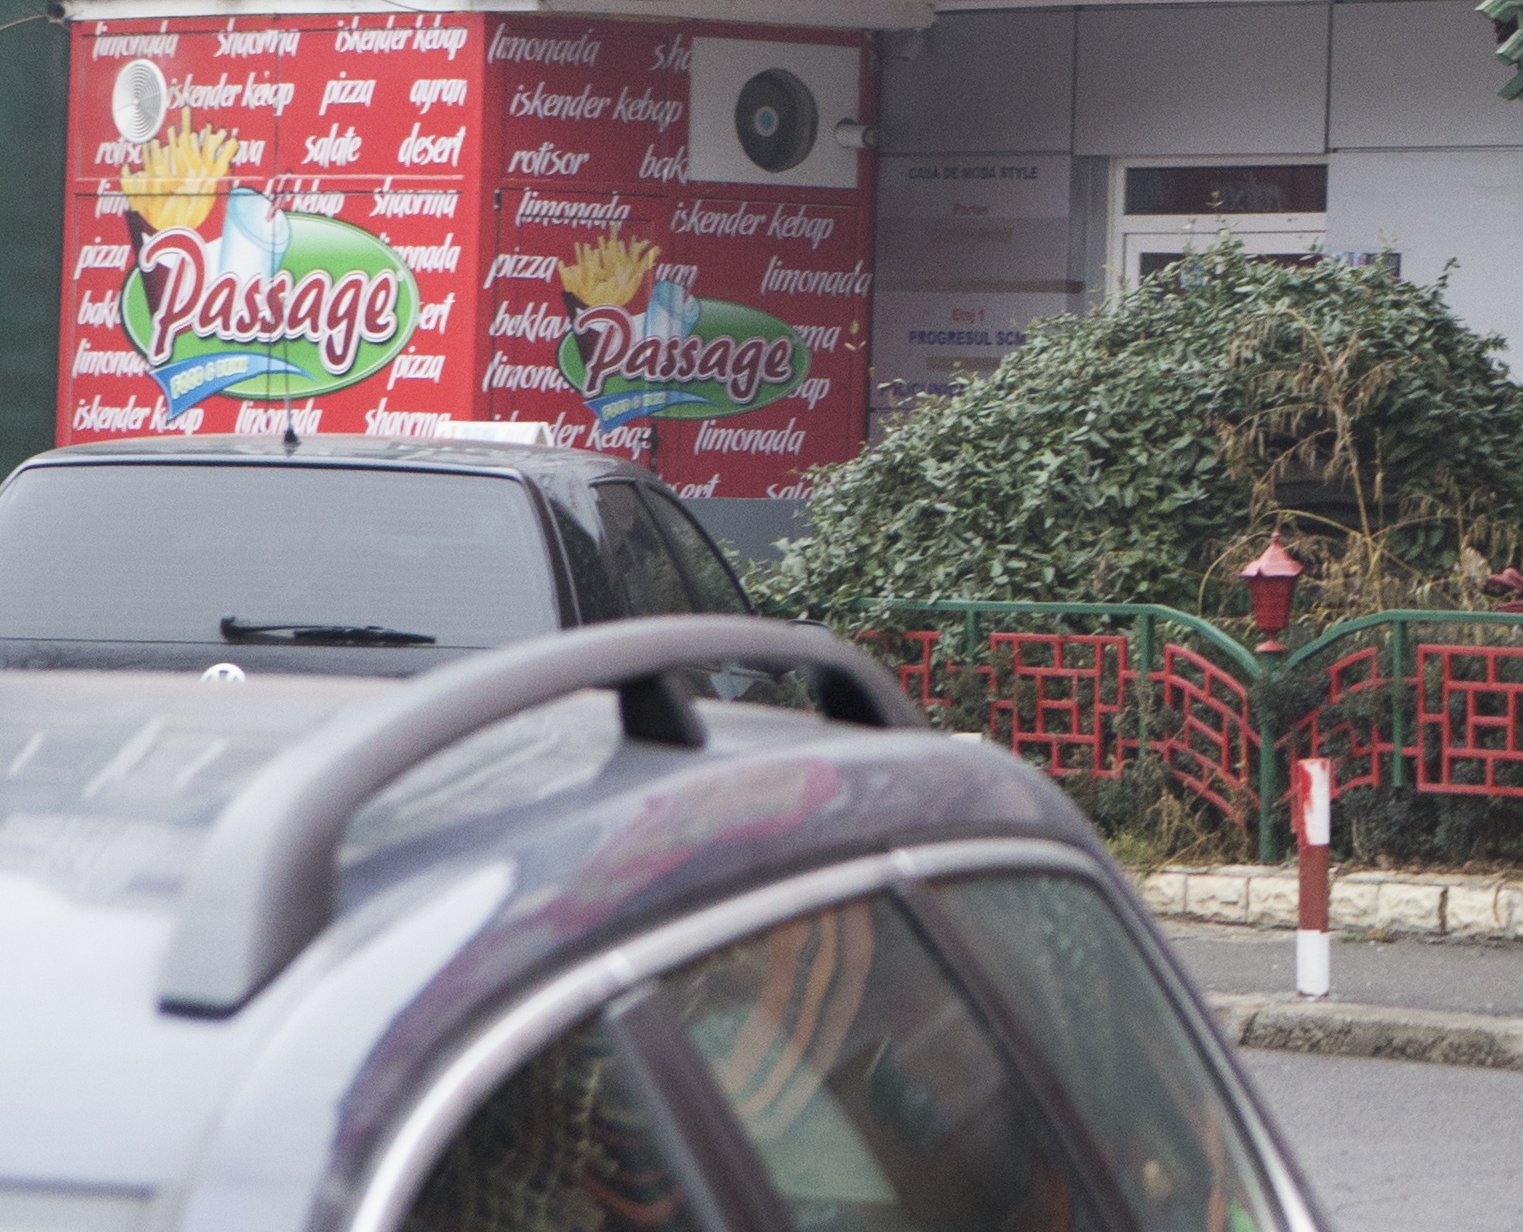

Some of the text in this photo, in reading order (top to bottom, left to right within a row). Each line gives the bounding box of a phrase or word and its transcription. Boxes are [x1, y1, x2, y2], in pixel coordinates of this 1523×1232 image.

[335, 15, 413, 55] iskender
[412, 14, 468, 61] kebap
[487, 22, 600, 67] limonada
[165, 72, 242, 110] iskender
[318, 71, 377, 116] pizza
[409, 79, 468, 115] ayran
[509, 81, 683, 133] iskender kebap
[301, 122, 363, 168] salate
[397, 121, 467, 167] desert
[508, 141, 590, 176] rotisor
[369, 176, 460, 218] shaorma
[515, 187, 834, 249] limonada iskender kebap
[73, 236, 132, 280] pizza
[483, 246, 559, 289] pizza
[760, 255, 873, 298] limonada
[139, 226, 400, 376] Passage
[489, 301, 571, 343] baklav
[573, 303, 792, 404] Passage
[909, 330, 992, 346] PROGRESUL
[387, 345, 446, 390] pizza
[73, 394, 151, 433] iskender
[693, 418, 806, 456] limonada
